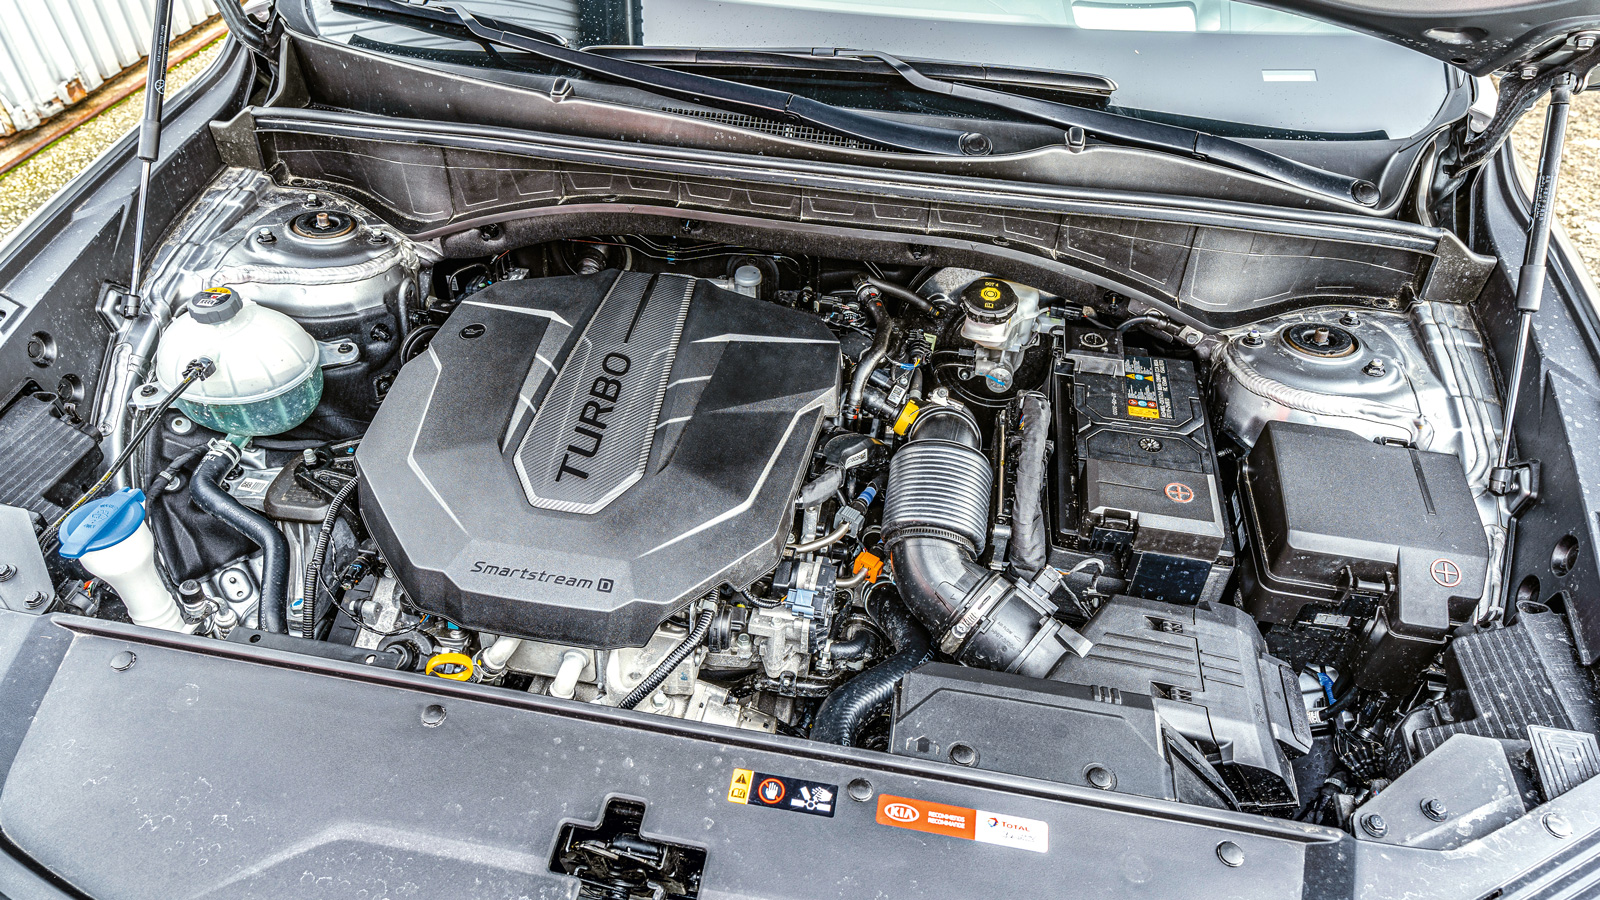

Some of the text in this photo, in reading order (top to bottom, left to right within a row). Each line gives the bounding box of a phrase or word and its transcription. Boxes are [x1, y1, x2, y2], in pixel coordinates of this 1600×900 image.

[555, 352, 631, 482] TURBO
[470, 561, 593, 589] Smartstream
[890, 806, 915, 820] KIA
[928, 811, 965, 822] RECOMMENDS
[1002, 821, 1030, 832] TOTAL
